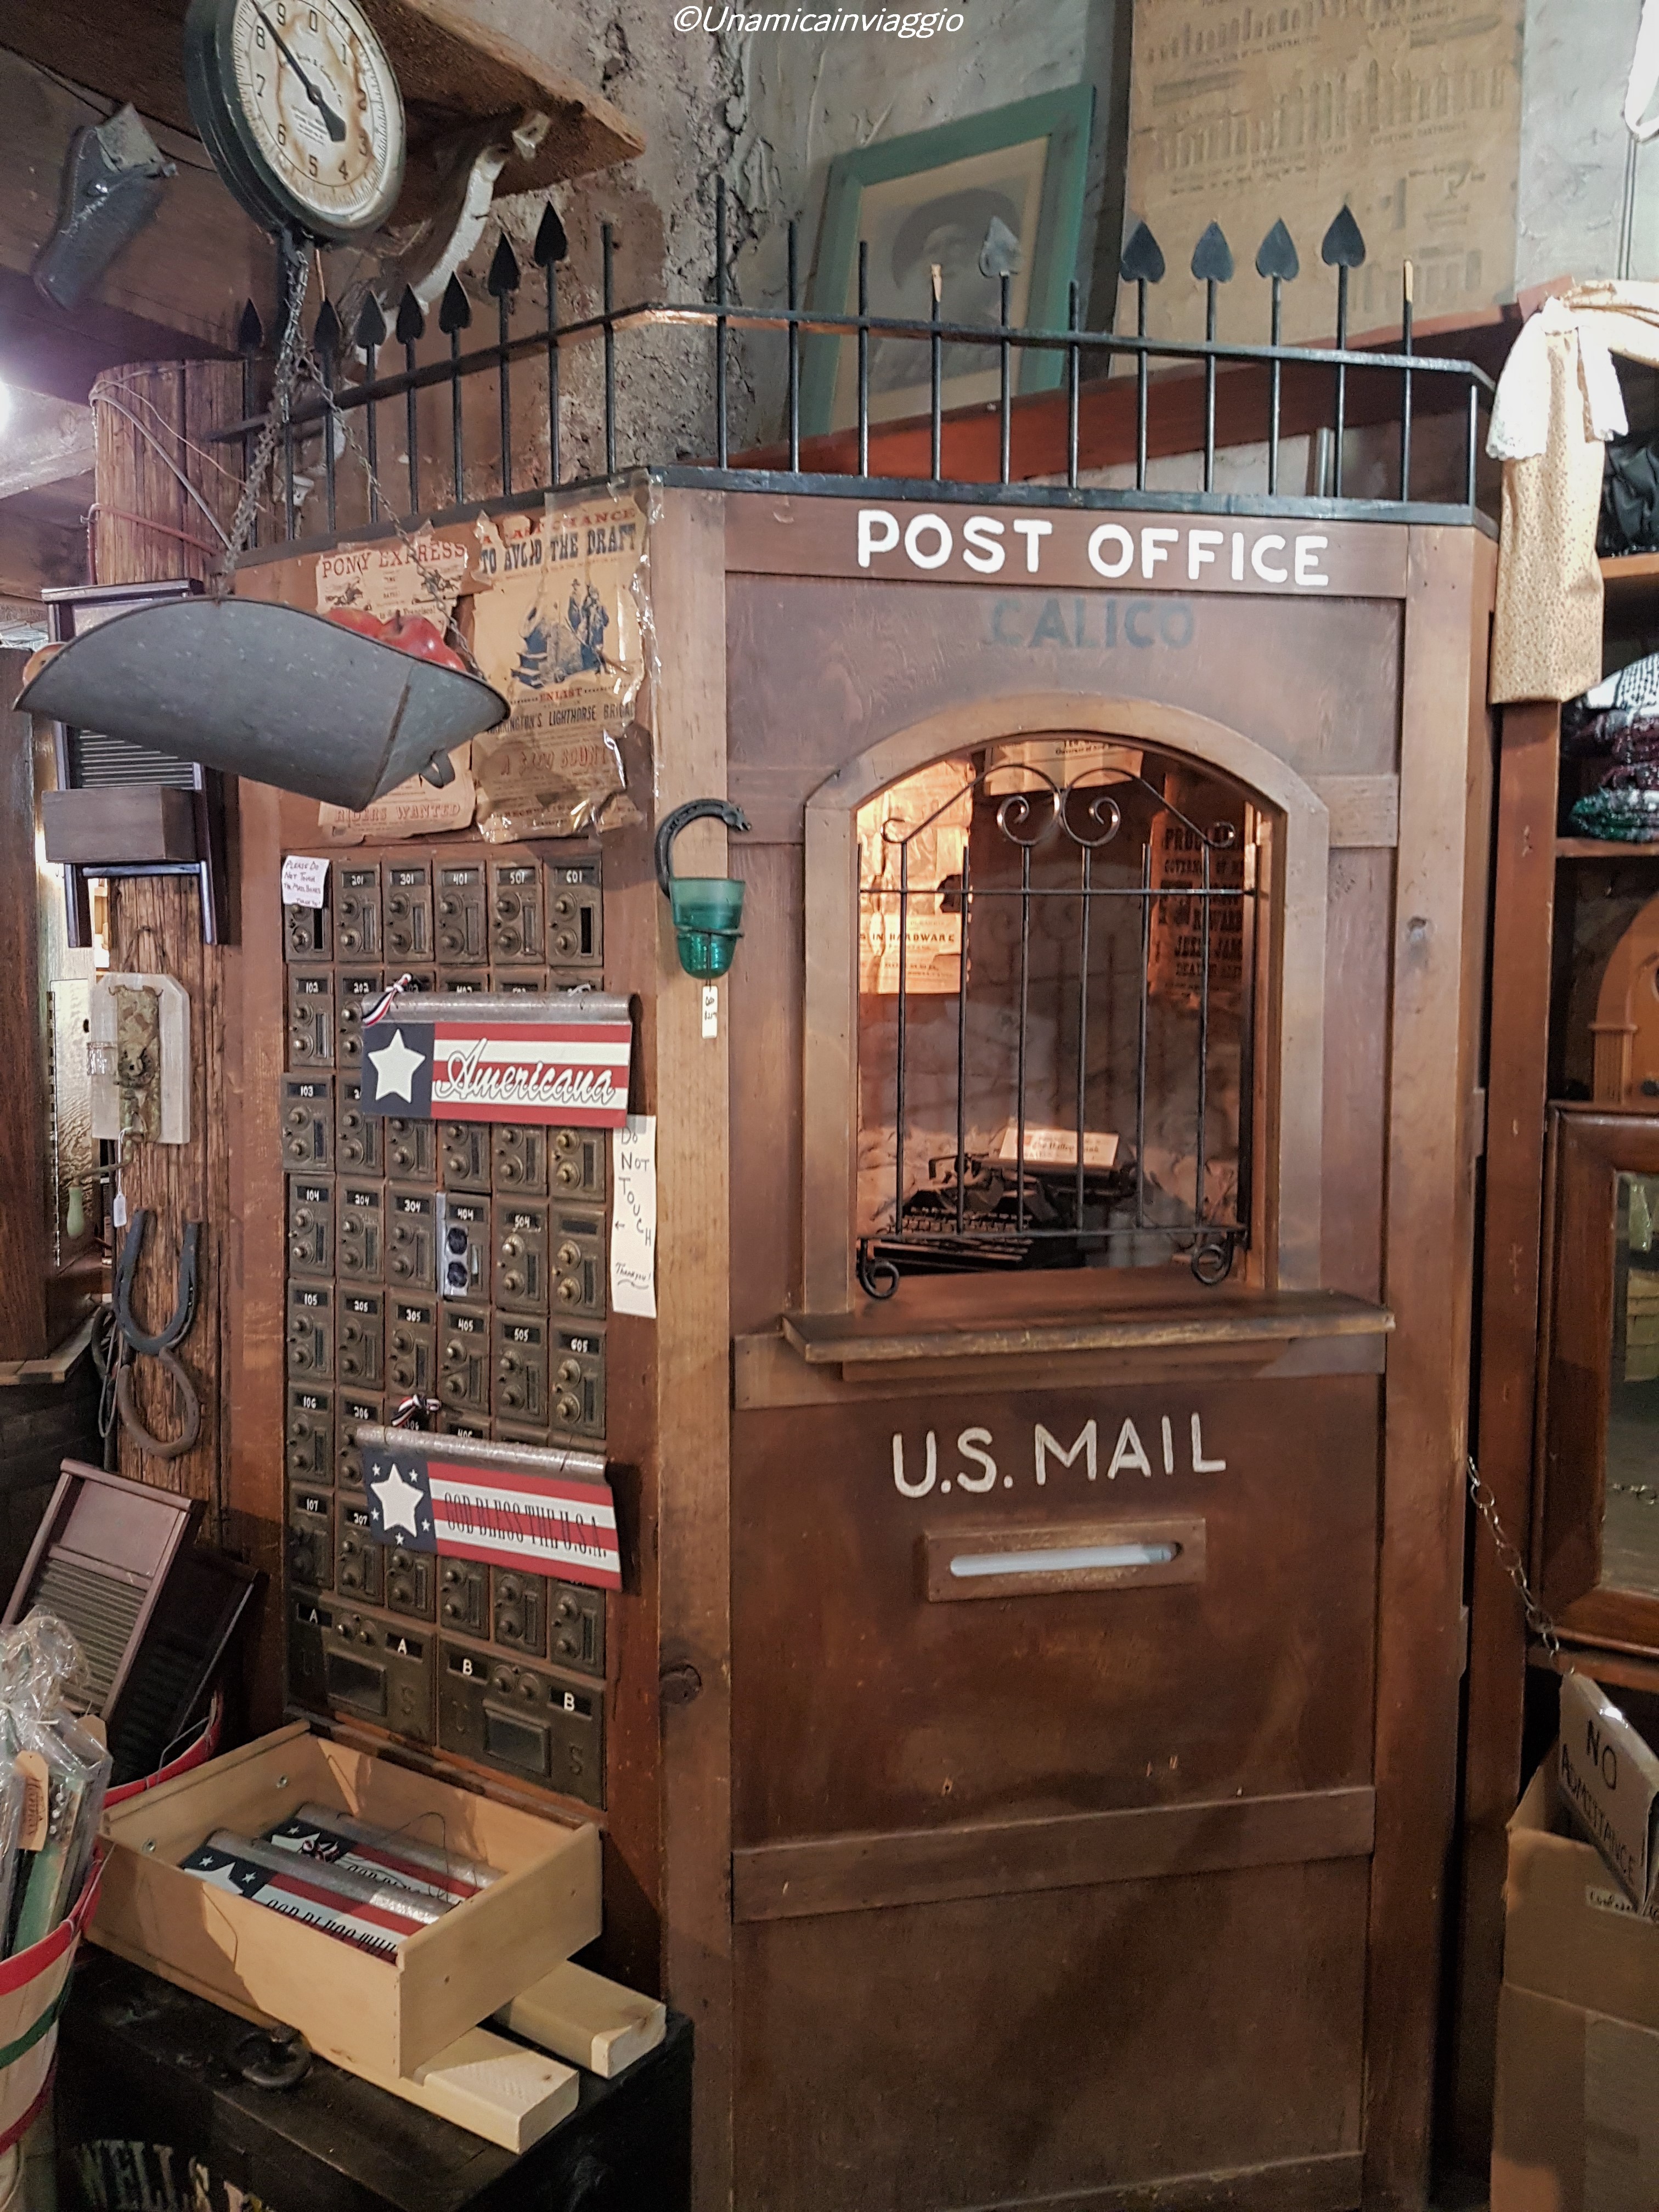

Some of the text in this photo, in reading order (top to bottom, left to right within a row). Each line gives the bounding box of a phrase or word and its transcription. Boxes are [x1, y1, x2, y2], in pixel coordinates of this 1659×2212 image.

[481, 548, 496, 574] TO
[550, 531, 578, 562] THE
[586, 523, 636, 556] DRAFT
[857, 509, 1329, 586] POST OFFICE
[322, 552, 371, 578] PONY
[991, 597, 1195, 650] CALICO
[538, 687, 583, 702] ENLIST
[396, 803, 461, 820] WANTED
[351, 875, 364, 886] 201
[400, 873, 414, 885] 301
[453, 872, 468, 886] 401
[510, 871, 526, 884] 501
[566, 870, 583, 883] 601
[306, 982, 319, 994] 102
[354, 982, 370, 994] 202
[435, 1037, 615, 1105] Americana
[301, 1085, 313, 1098] 103
[621, 1152, 650, 1171] NOT
[306, 1189, 320, 1202] 104
[355, 1194, 369, 1206] 204
[404, 1199, 421, 1213] 304
[457, 1207, 474, 1221] 404
[304, 1293, 318, 1306] 105
[354, 1300, 368, 1313] 205
[406, 1309, 421, 1323] 305
[458, 1318, 474, 1333] 405
[514, 1328, 529, 1342] 505
[570, 1338, 589, 1353] 605
[303, 1396, 317, 1409] 106
[354, 1406, 369, 1420] 206
[893, 1412, 1227, 1498] U.S. MAIL
[306, 1499, 319, 1512] 107
[354, 1513, 368, 1526] 207
[309, 1608, 318, 1624] A
[398, 1638, 408, 1656] A
[462, 1658, 474, 1677] B
[563, 1692, 576, 1713] B
[1587, 1719, 1617, 1791] NO
